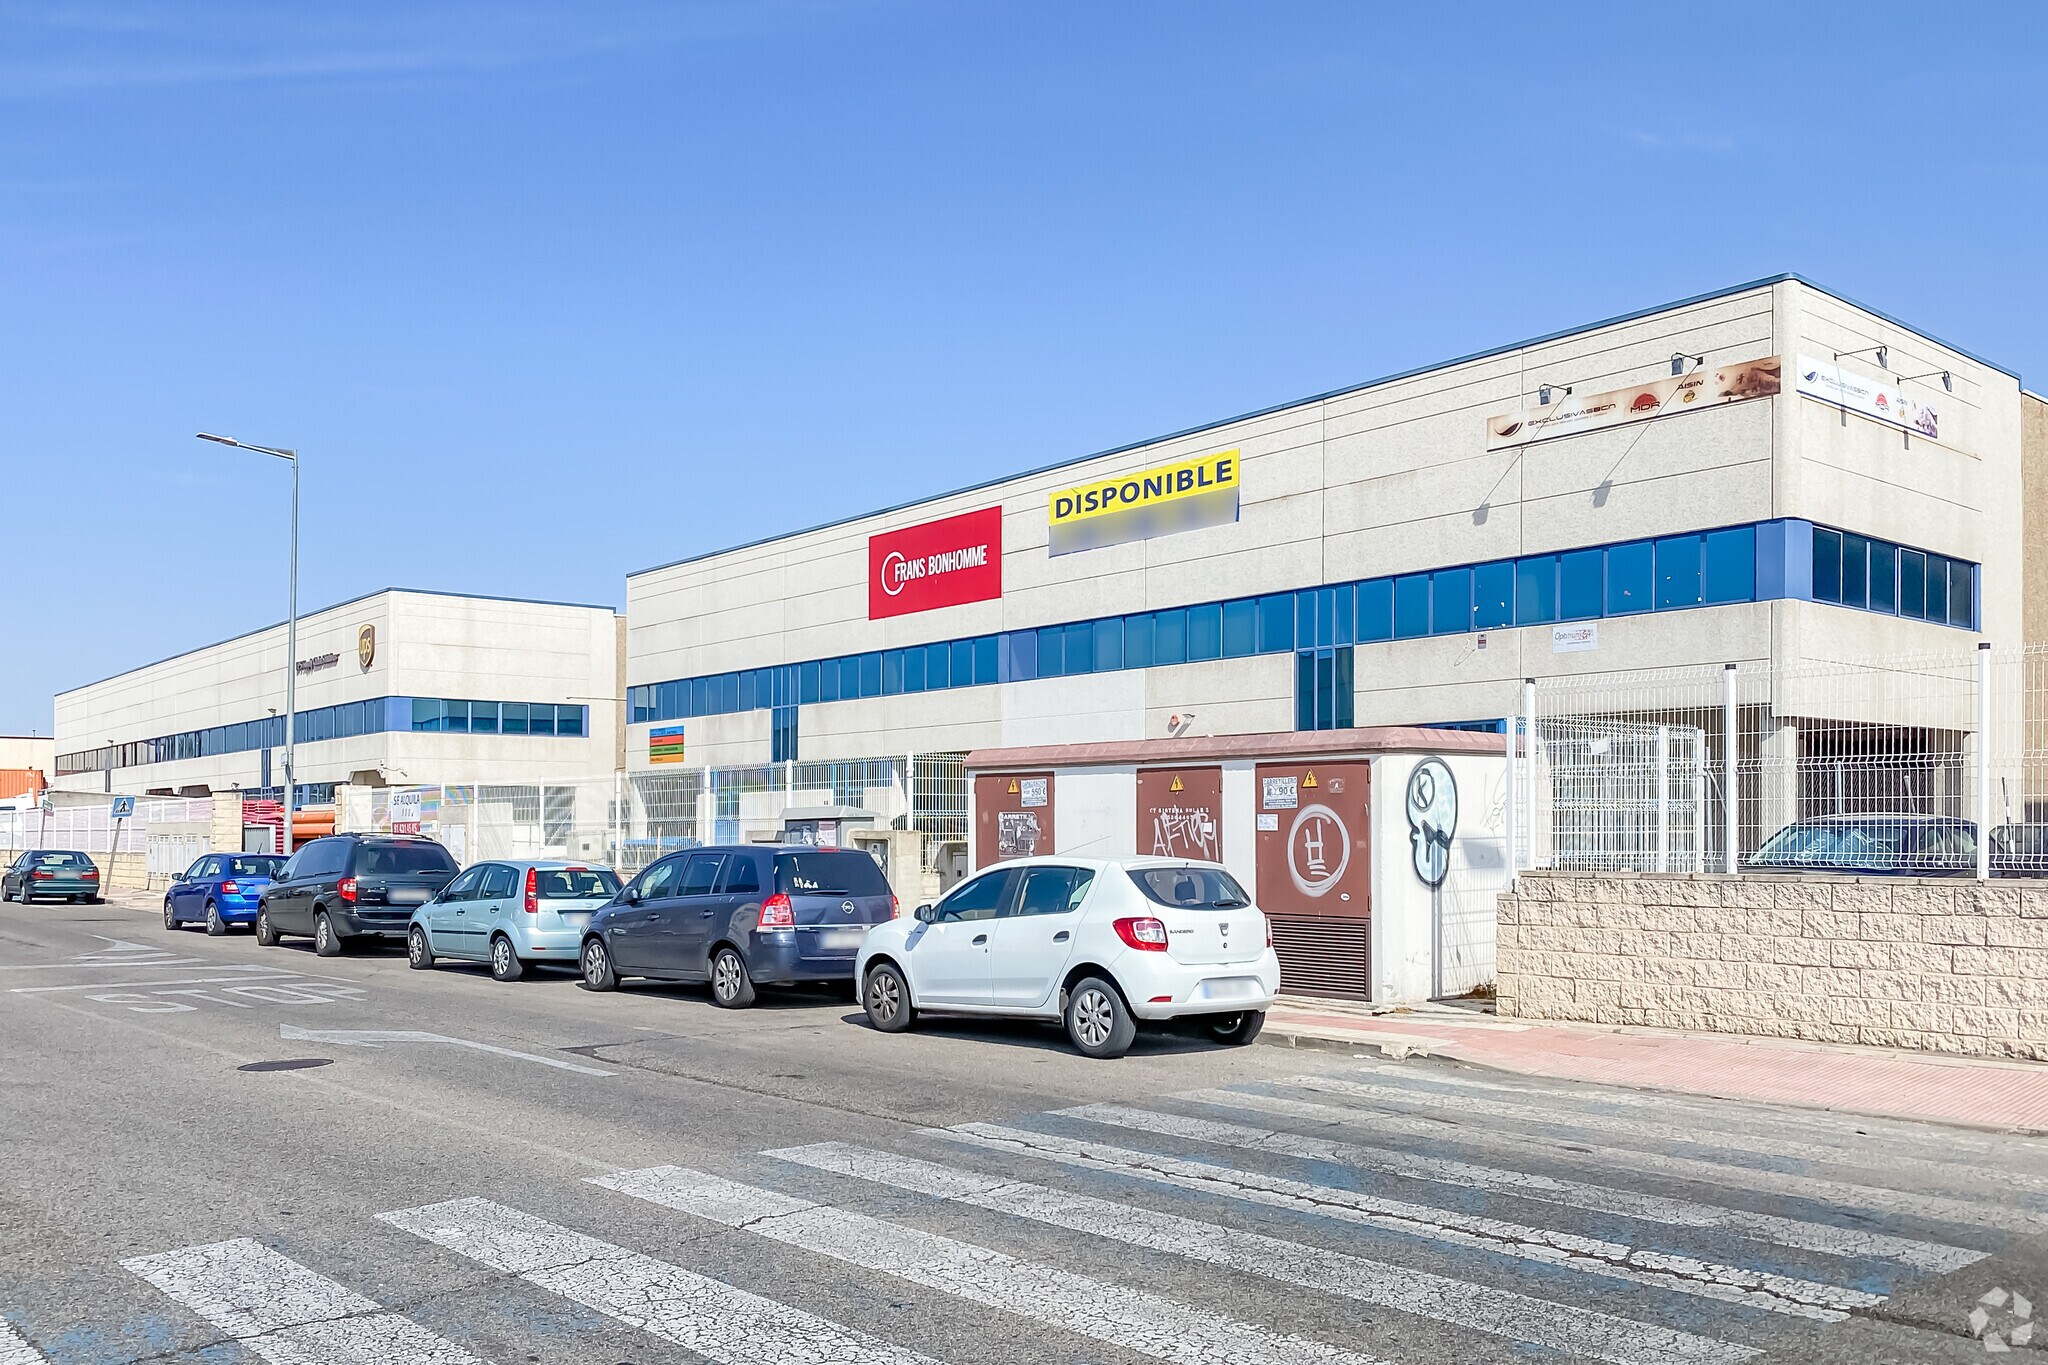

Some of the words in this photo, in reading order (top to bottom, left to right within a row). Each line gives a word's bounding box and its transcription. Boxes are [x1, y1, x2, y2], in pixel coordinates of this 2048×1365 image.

[1630, 401, 1660, 413] MDR
[1055, 459, 1233, 519] DISPONIBLE
[894, 557, 926, 582] FRANS
[928, 544, 988, 576] BONHOMME
